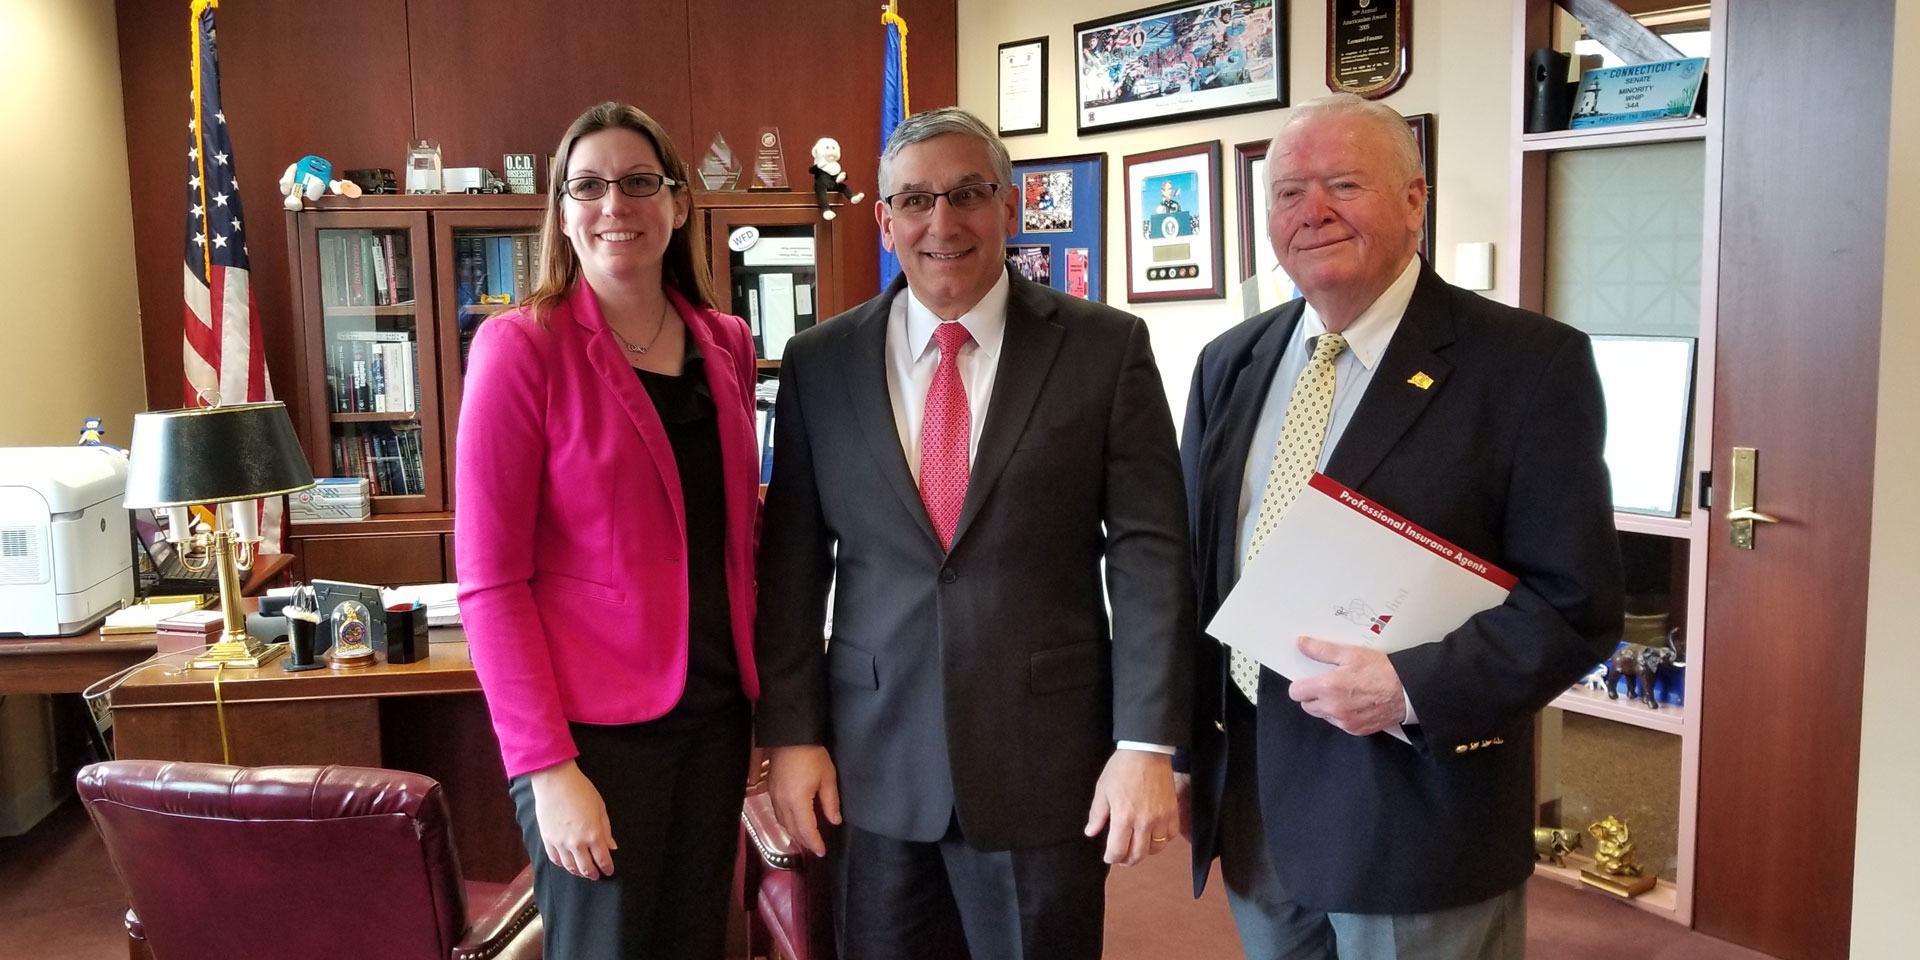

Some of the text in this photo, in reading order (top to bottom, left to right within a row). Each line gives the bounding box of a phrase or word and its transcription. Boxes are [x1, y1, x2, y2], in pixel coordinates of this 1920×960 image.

[1610, 62, 1674, 78] CONNECTICUT
[1625, 76, 1652, 85] SENATE
[1619, 85, 1654, 95] MINORITY
[1625, 94, 1644, 102] WHIP
[506, 155, 533, 170] O.C.D.
[732, 230, 754, 246] WFD
[1340, 490, 1488, 574] Professional Insurance Agents
